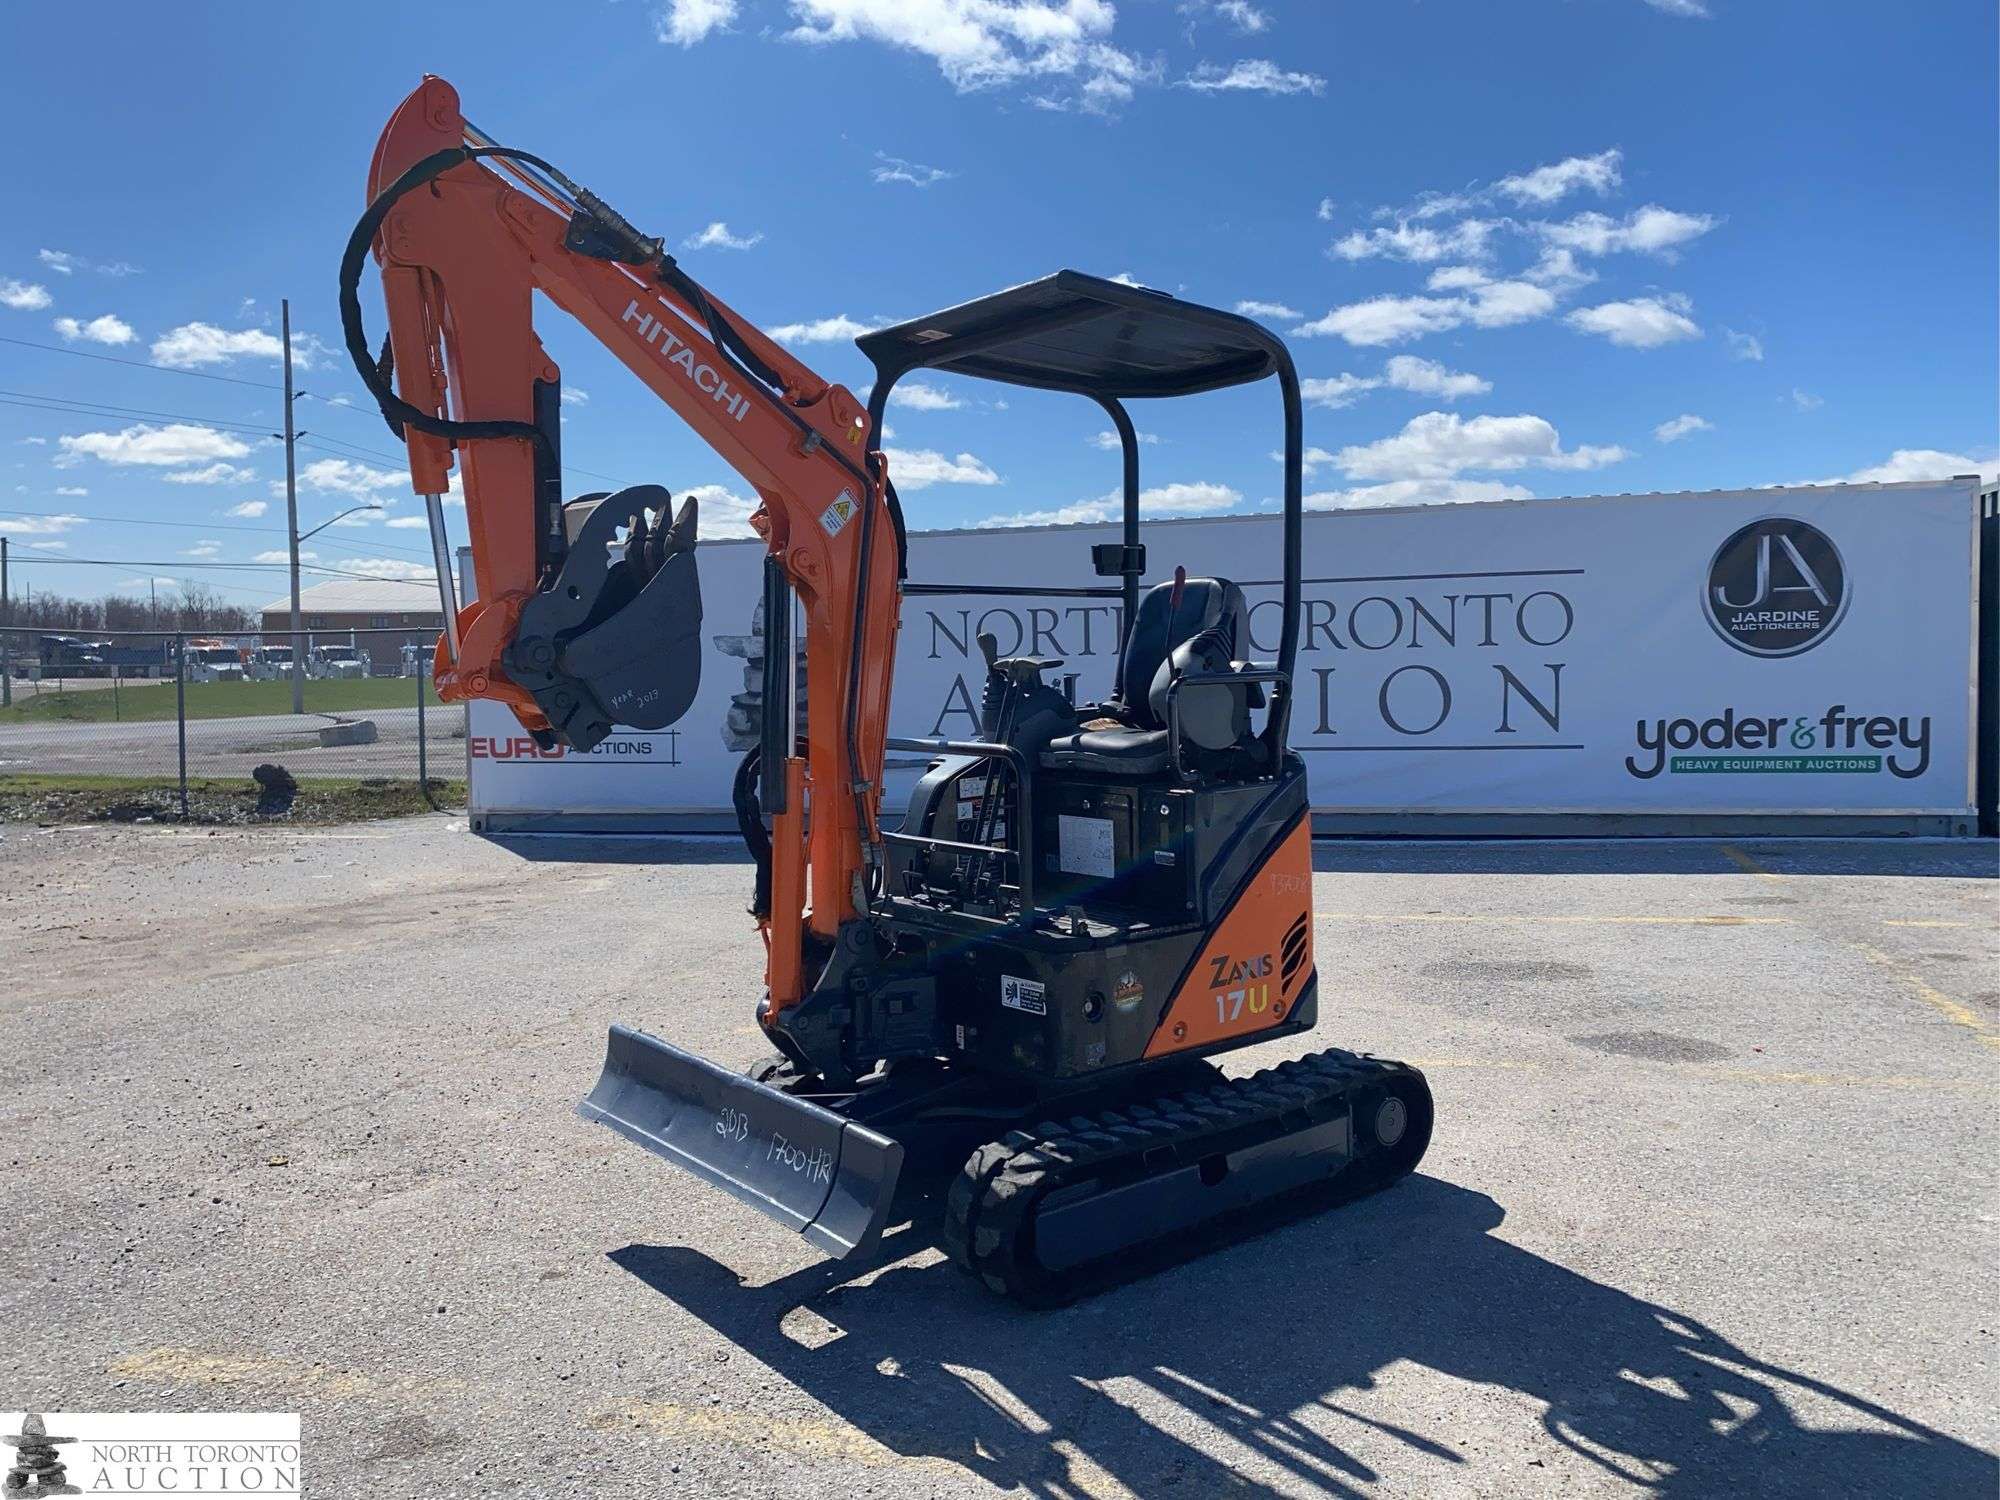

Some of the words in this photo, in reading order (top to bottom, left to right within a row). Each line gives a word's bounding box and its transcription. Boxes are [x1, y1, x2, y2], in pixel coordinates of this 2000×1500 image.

[621, 298, 751, 423] HITACHI
[1713, 533, 1834, 608] JA
[1248, 591, 1574, 653] ORONTO
[1731, 610, 1820, 623] JARDINE
[1731, 622, 1820, 632] AUCTIONEERS
[636, 688, 660, 708] 2013
[928, 663, 1566, 738] AION
[1676, 760, 1719, 770] HEAVY
[1723, 760, 1803, 770] EQUIPMENT
[1806, 760, 1877, 770] AUCTIONS
[1209, 953, 1274, 989] ZAXIS
[1215, 984, 1268, 1024] 17U
